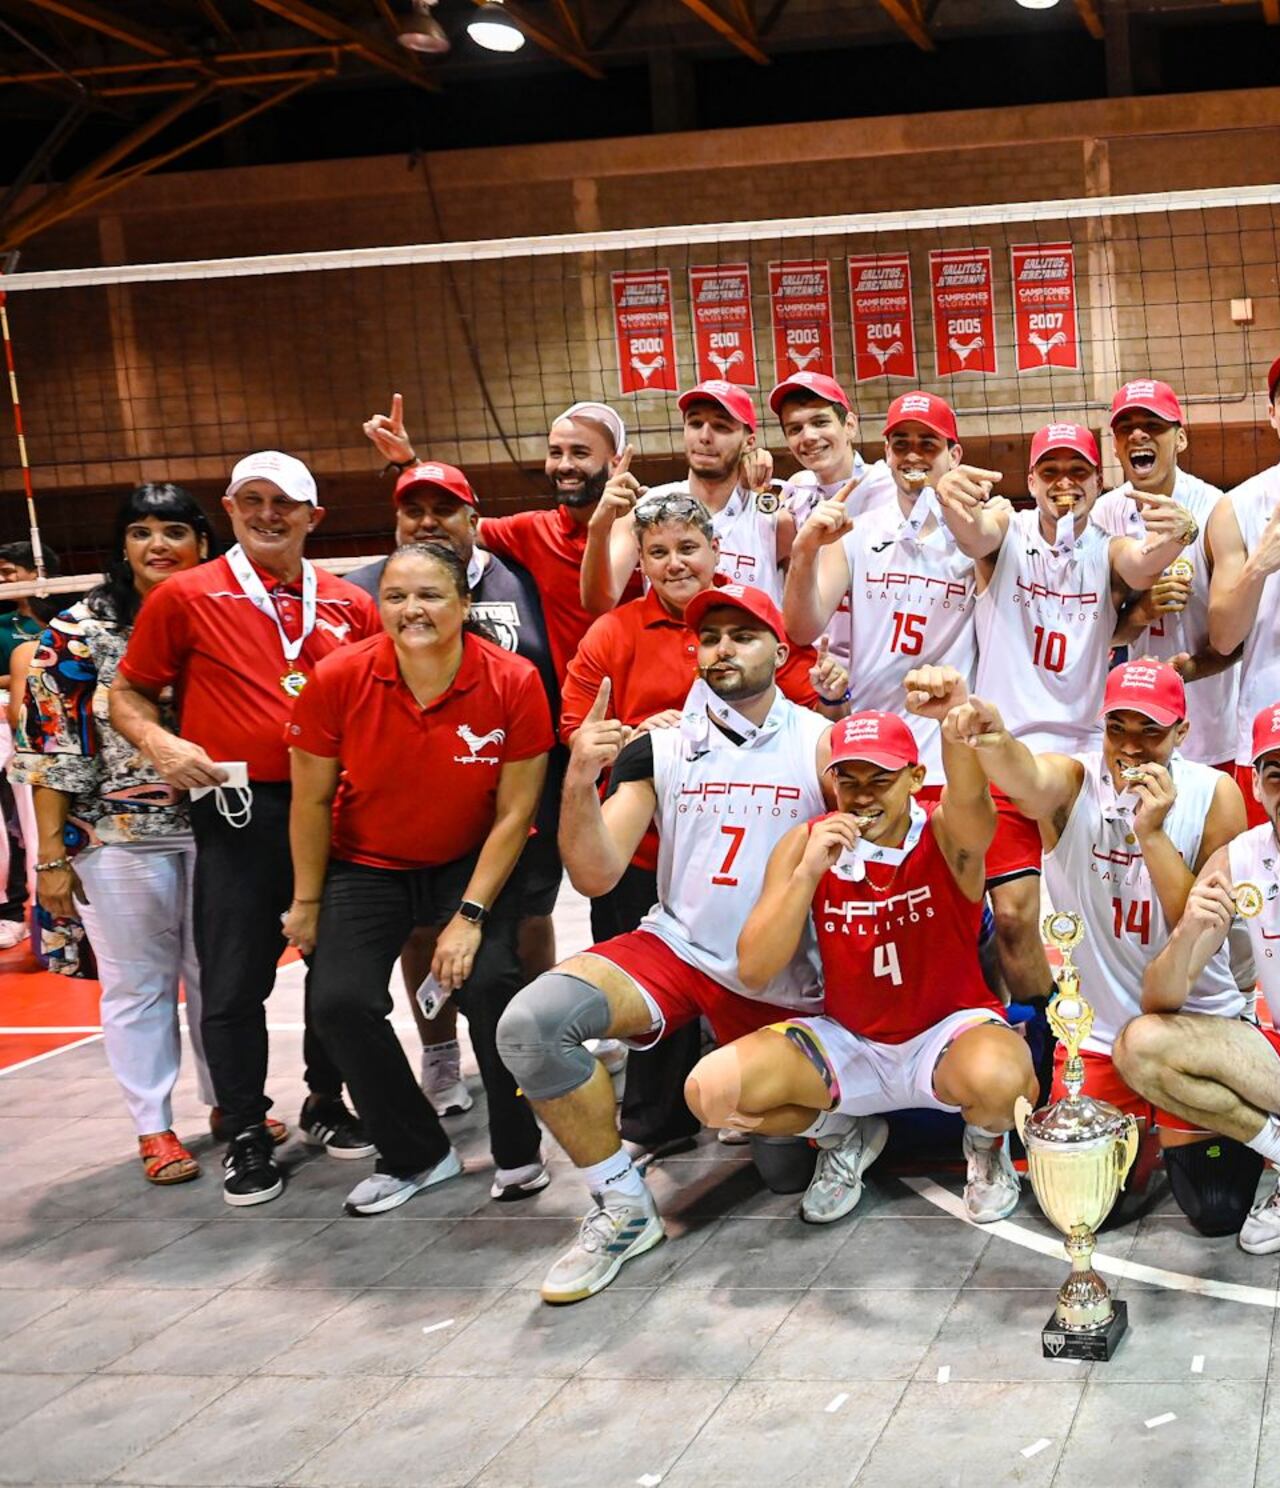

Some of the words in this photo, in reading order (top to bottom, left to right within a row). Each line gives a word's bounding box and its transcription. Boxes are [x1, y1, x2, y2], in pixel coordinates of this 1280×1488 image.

[1024, 256, 1066, 269] GALLITOS
[937, 292, 989, 302] CAMPEONES
[1019, 286, 1070, 296] CAMPEONES
[776, 302, 826, 312] CAMPEONES
[856, 296, 907, 307] CAMPEONES
[697, 306, 747, 316] CAMPEONES
[948, 318, 981, 335] 2005
[1029, 313, 1063, 330] 2007
[786, 328, 820, 344] 2003
[866, 322, 902, 340] 2004
[630, 338, 664, 354] 2000
[710, 332, 739, 349] 2001
[866, 571, 966, 599] uprrp
[866, 591, 966, 612] GALLITOS
[890, 611, 927, 657] 15
[1033, 625, 1068, 673] 10
[681, 782, 801, 805] uprrp
[678, 804, 798, 819] GALLITOS
[712, 825, 746, 886] 7
[824, 885, 932, 923] uprrp
[824, 907, 935, 936] GALLITOS
[1112, 896, 1150, 945] 14
[873, 942, 903, 986] 4
